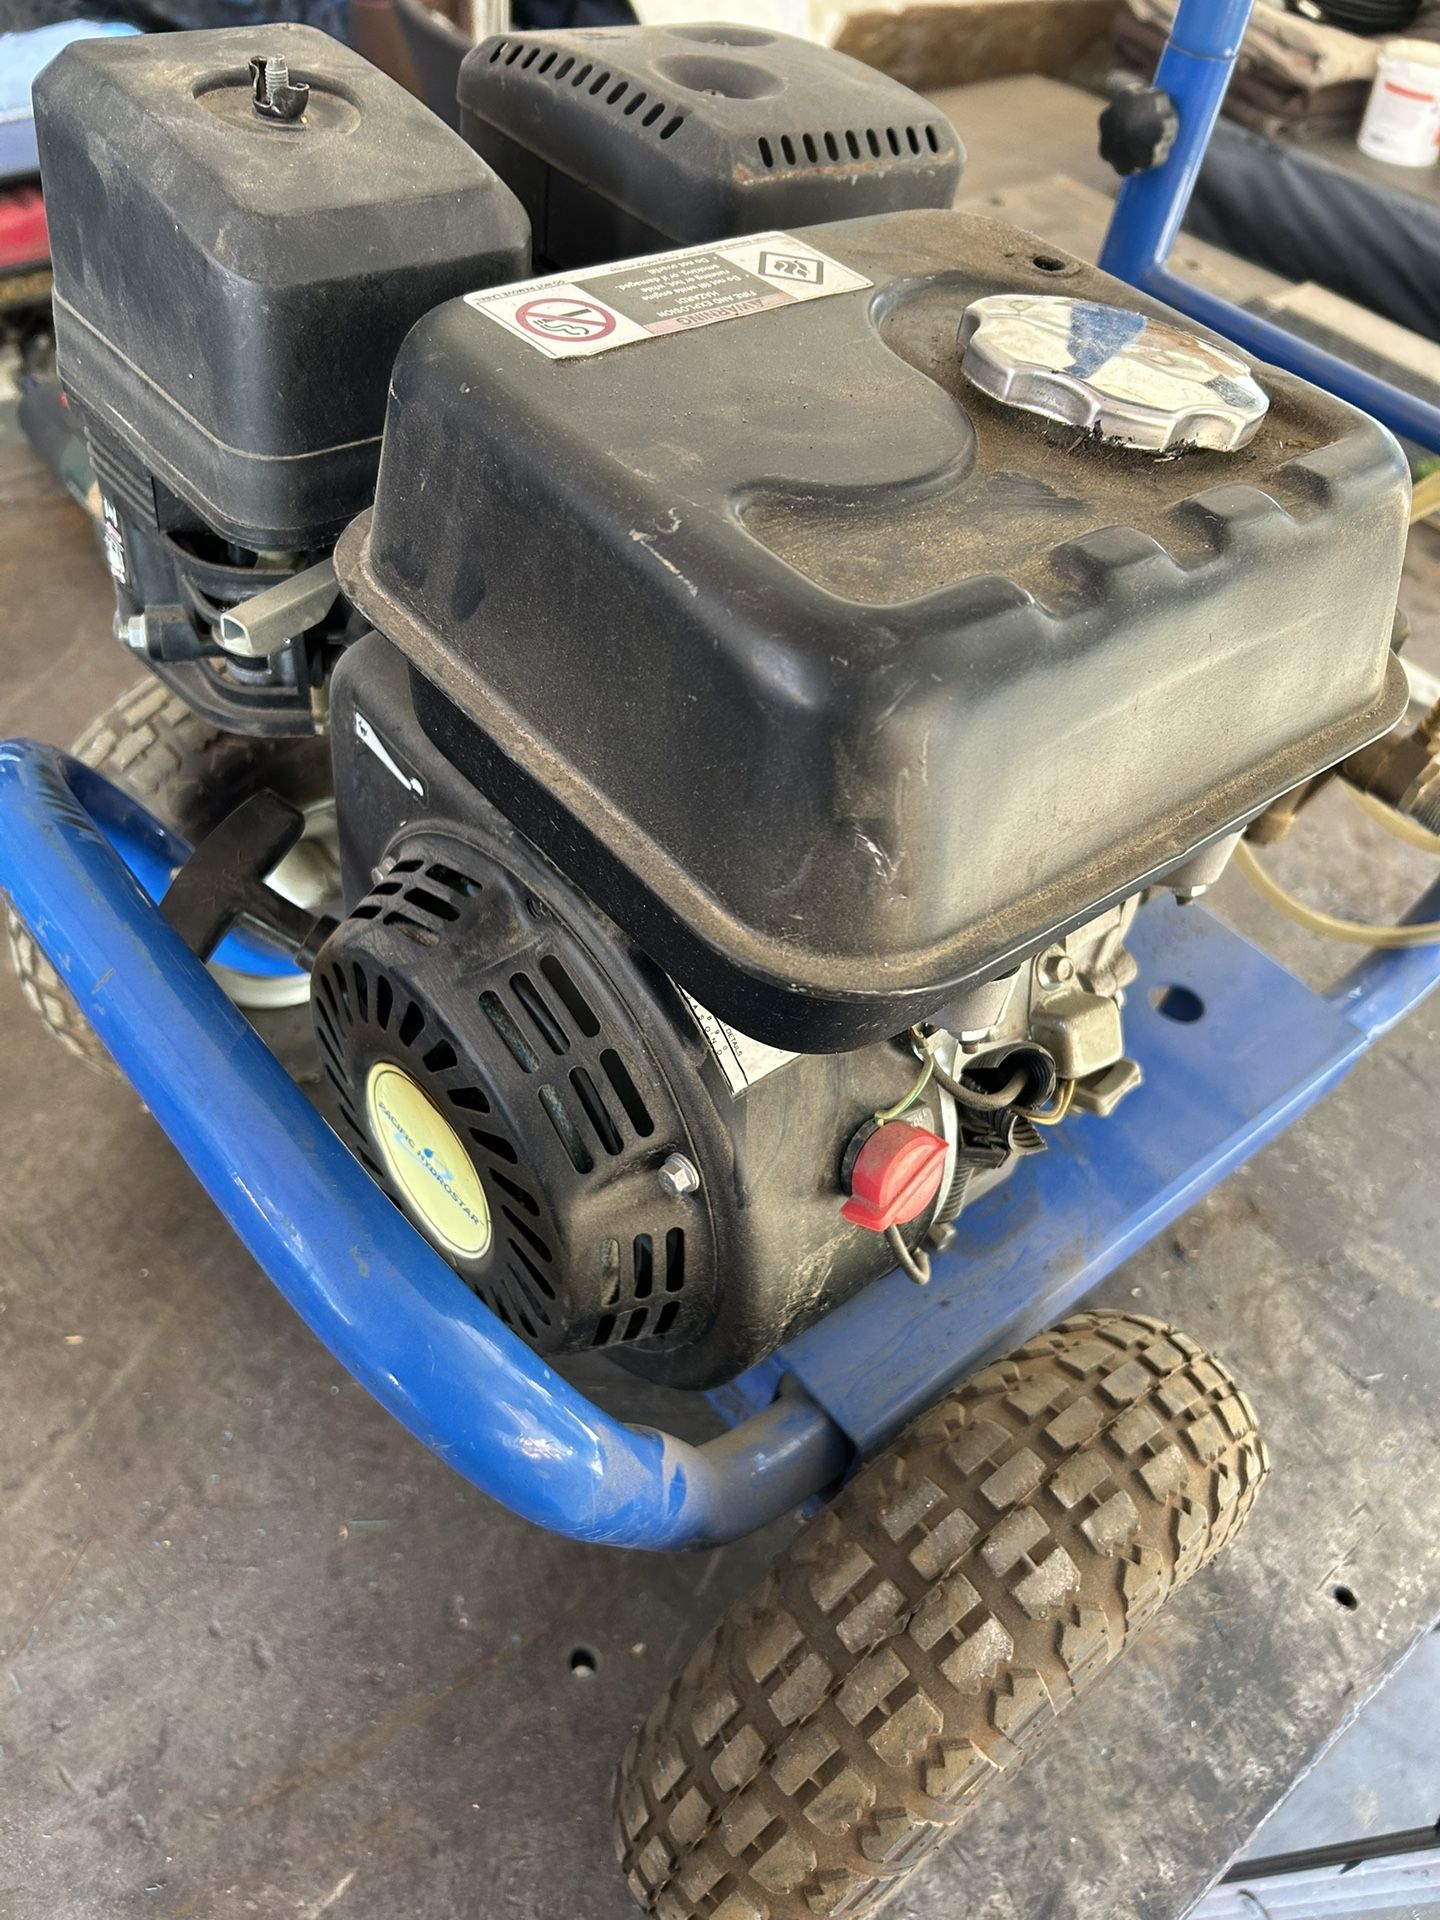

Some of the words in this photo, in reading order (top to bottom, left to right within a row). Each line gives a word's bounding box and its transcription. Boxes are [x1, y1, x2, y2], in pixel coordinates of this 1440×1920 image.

[694, 270, 730, 280] running
[640, 284, 666, 292] while
[673, 285, 698, 293] while
[641, 291, 673, 301] engine
[675, 291, 720, 304] HAZARD!
[712, 295, 734, 304] AND
[733, 290, 757, 299] FIRE
[656, 300, 714, 317] EXPLOSION
[676, 302, 756, 324] WARNING
[726, 1028, 743, 1057] DETAILS
[378, 1101, 416, 1150] PACIFIC
[417, 1150, 480, 1225] HYDROSTAR
